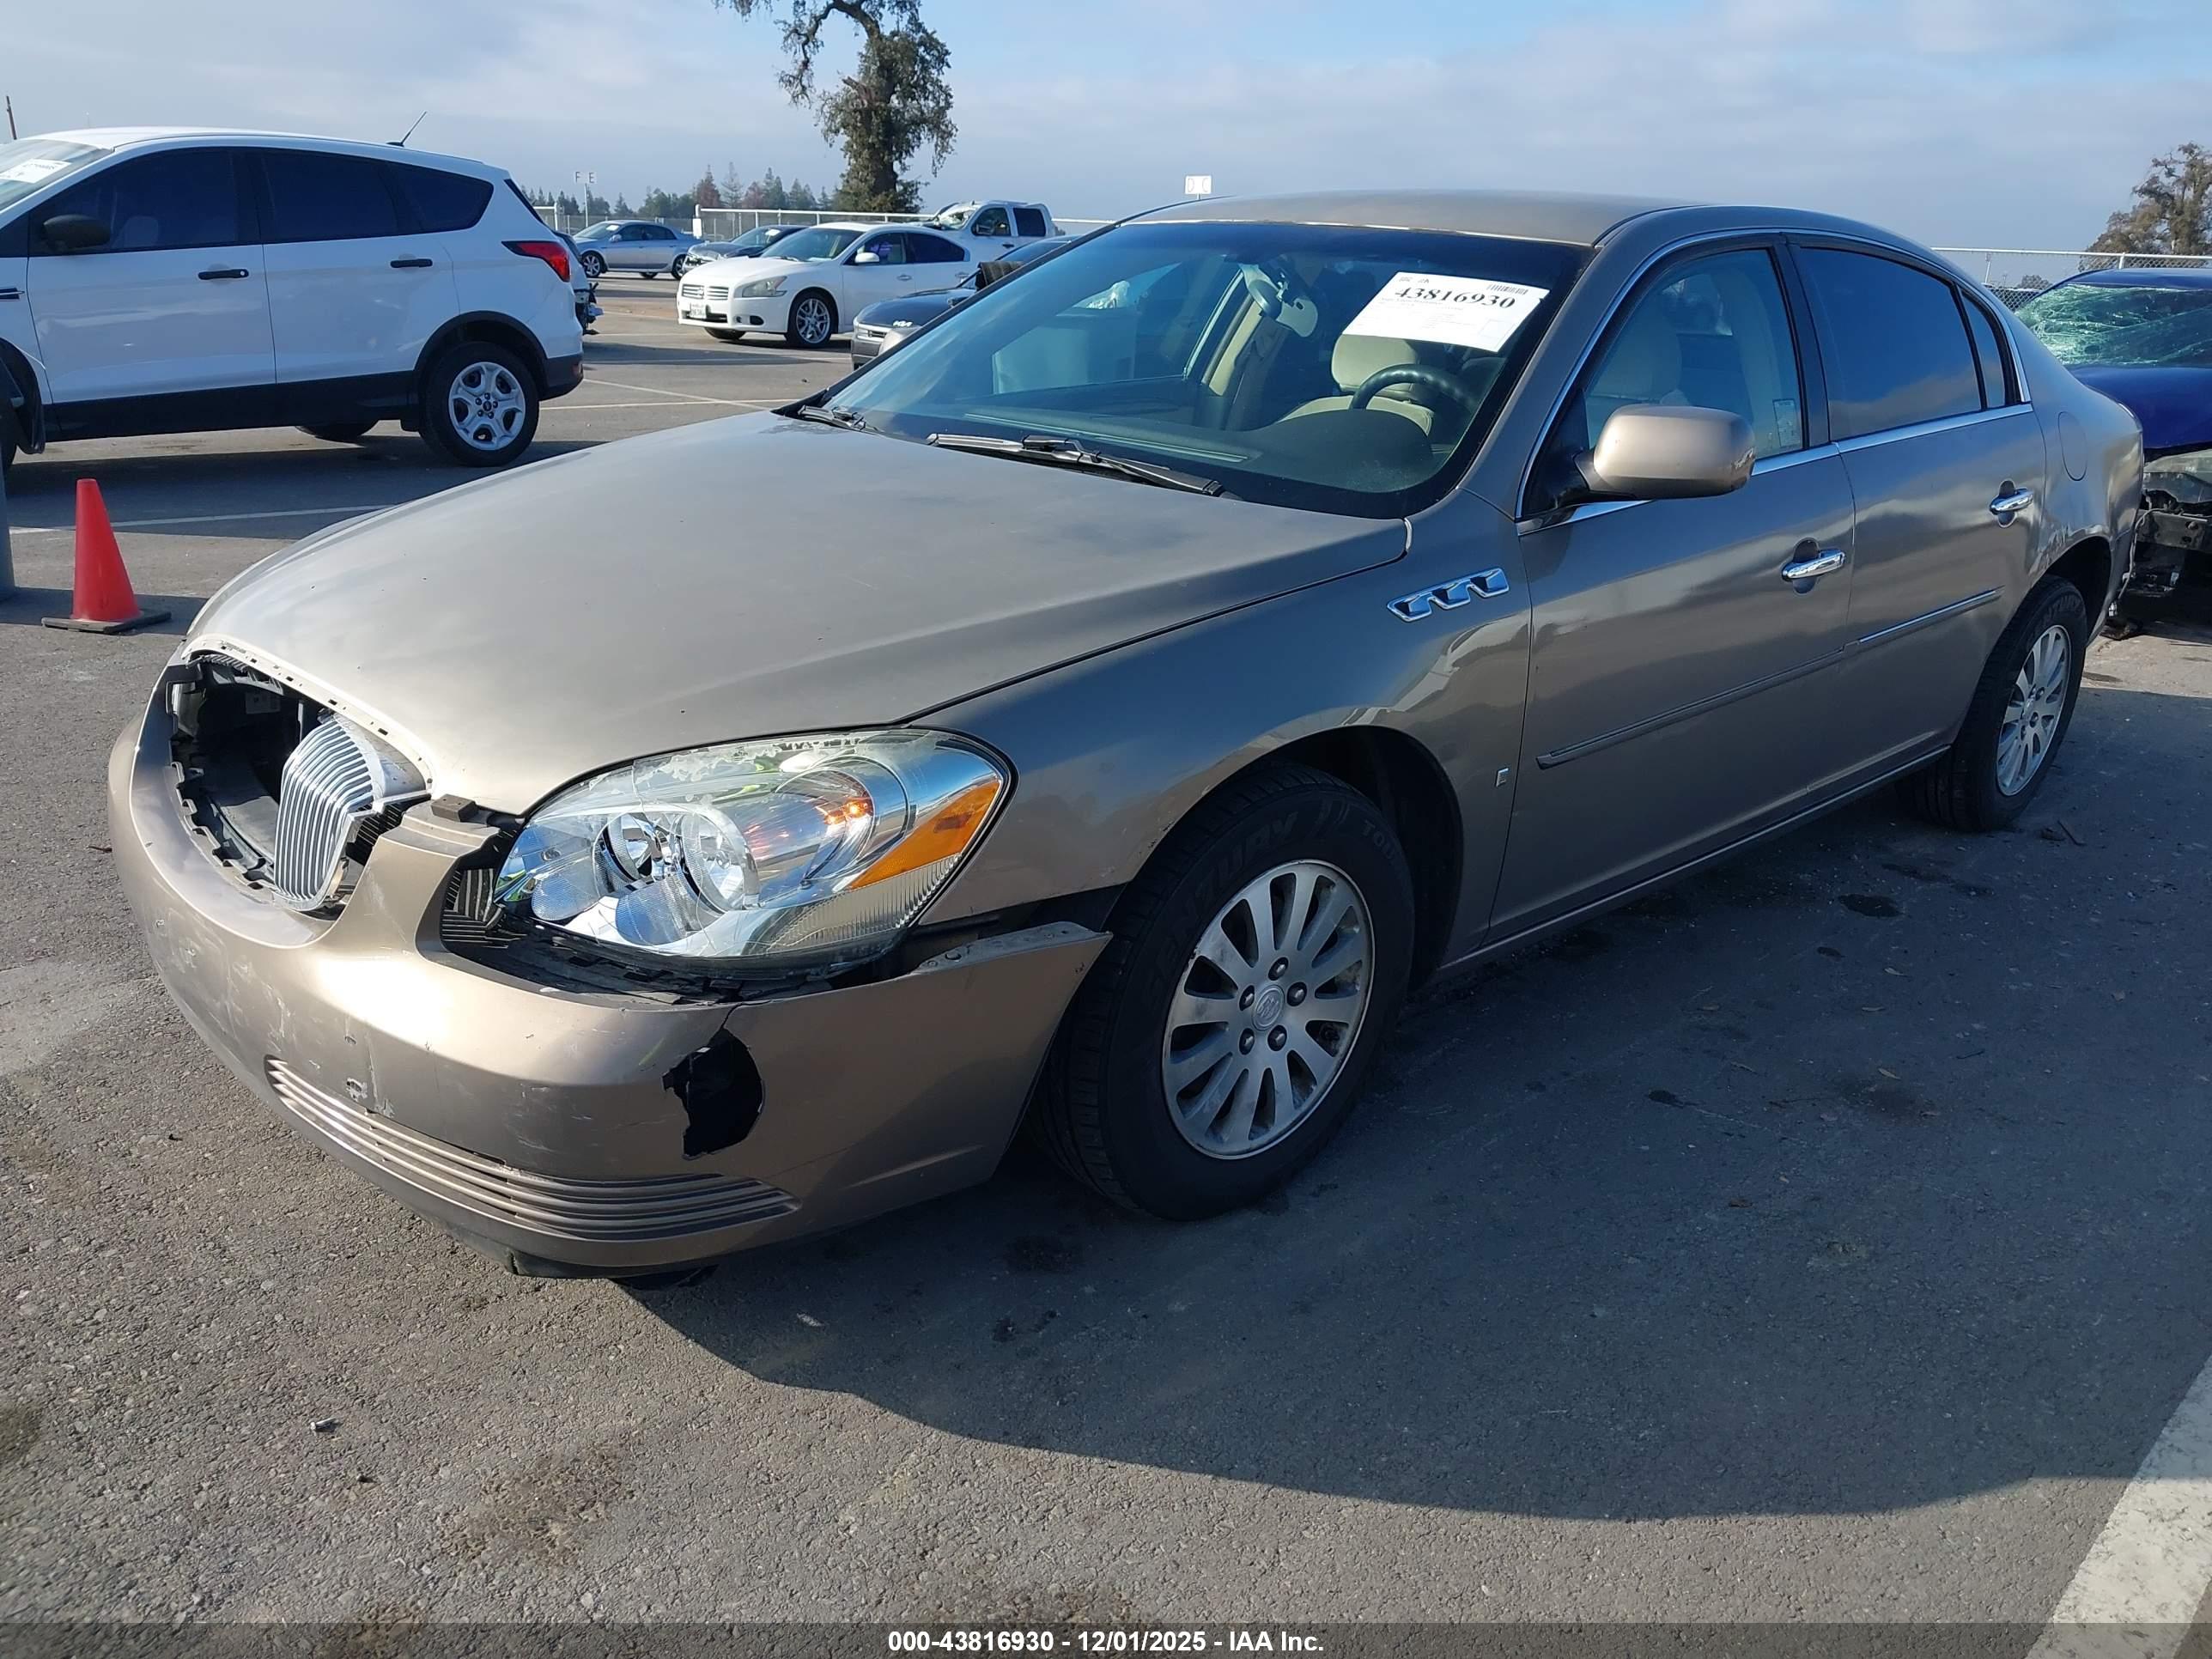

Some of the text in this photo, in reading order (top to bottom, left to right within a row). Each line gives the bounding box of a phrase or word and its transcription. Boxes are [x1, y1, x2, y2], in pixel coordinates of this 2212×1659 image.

[575, 171, 595, 184] F E
[1395, 287, 1516, 309] 43816930
